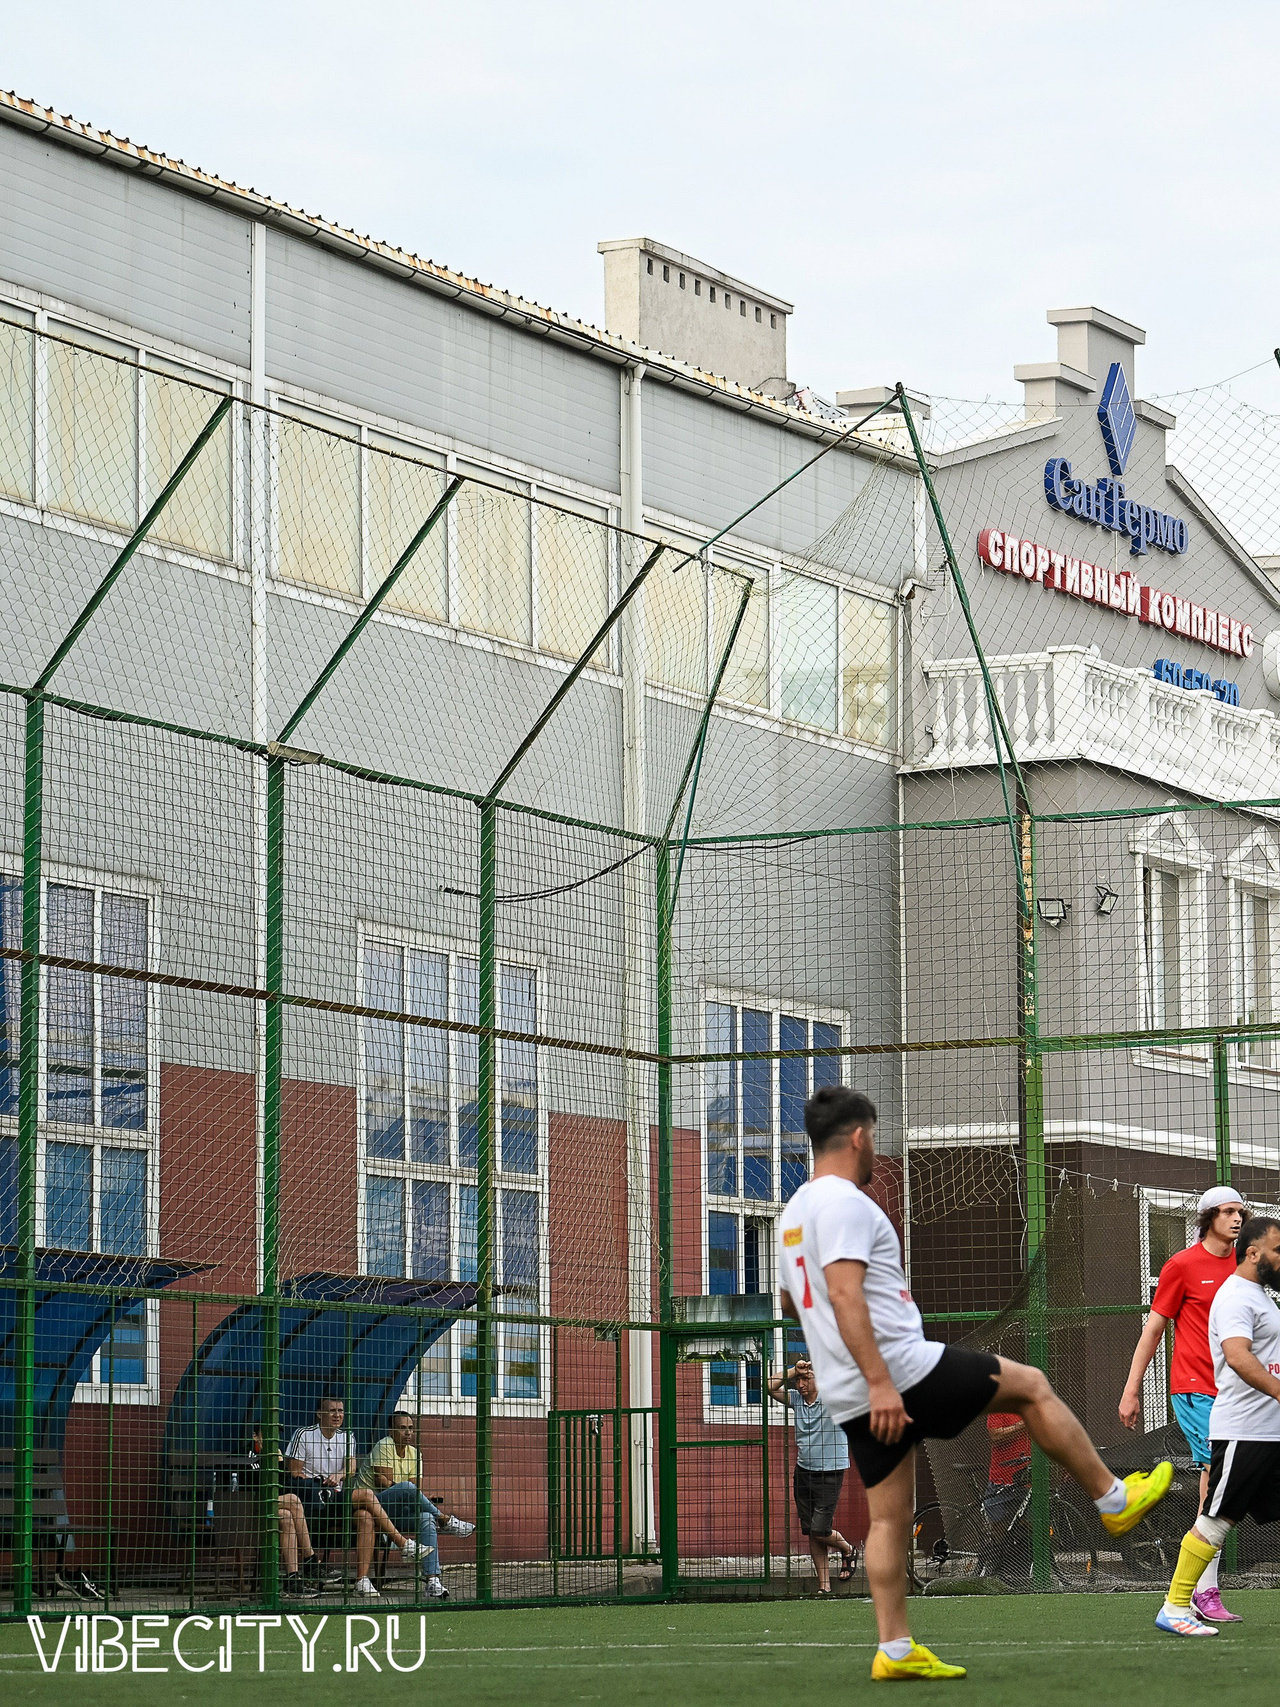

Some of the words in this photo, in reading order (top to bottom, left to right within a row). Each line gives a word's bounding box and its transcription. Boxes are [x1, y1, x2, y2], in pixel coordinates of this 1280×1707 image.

[1045, 457, 1189, 556] СанТермо
[979, 527, 1142, 617] СПОРТИВНЫЙ
[1141, 586, 1255, 659] КОМПЛЕКС
